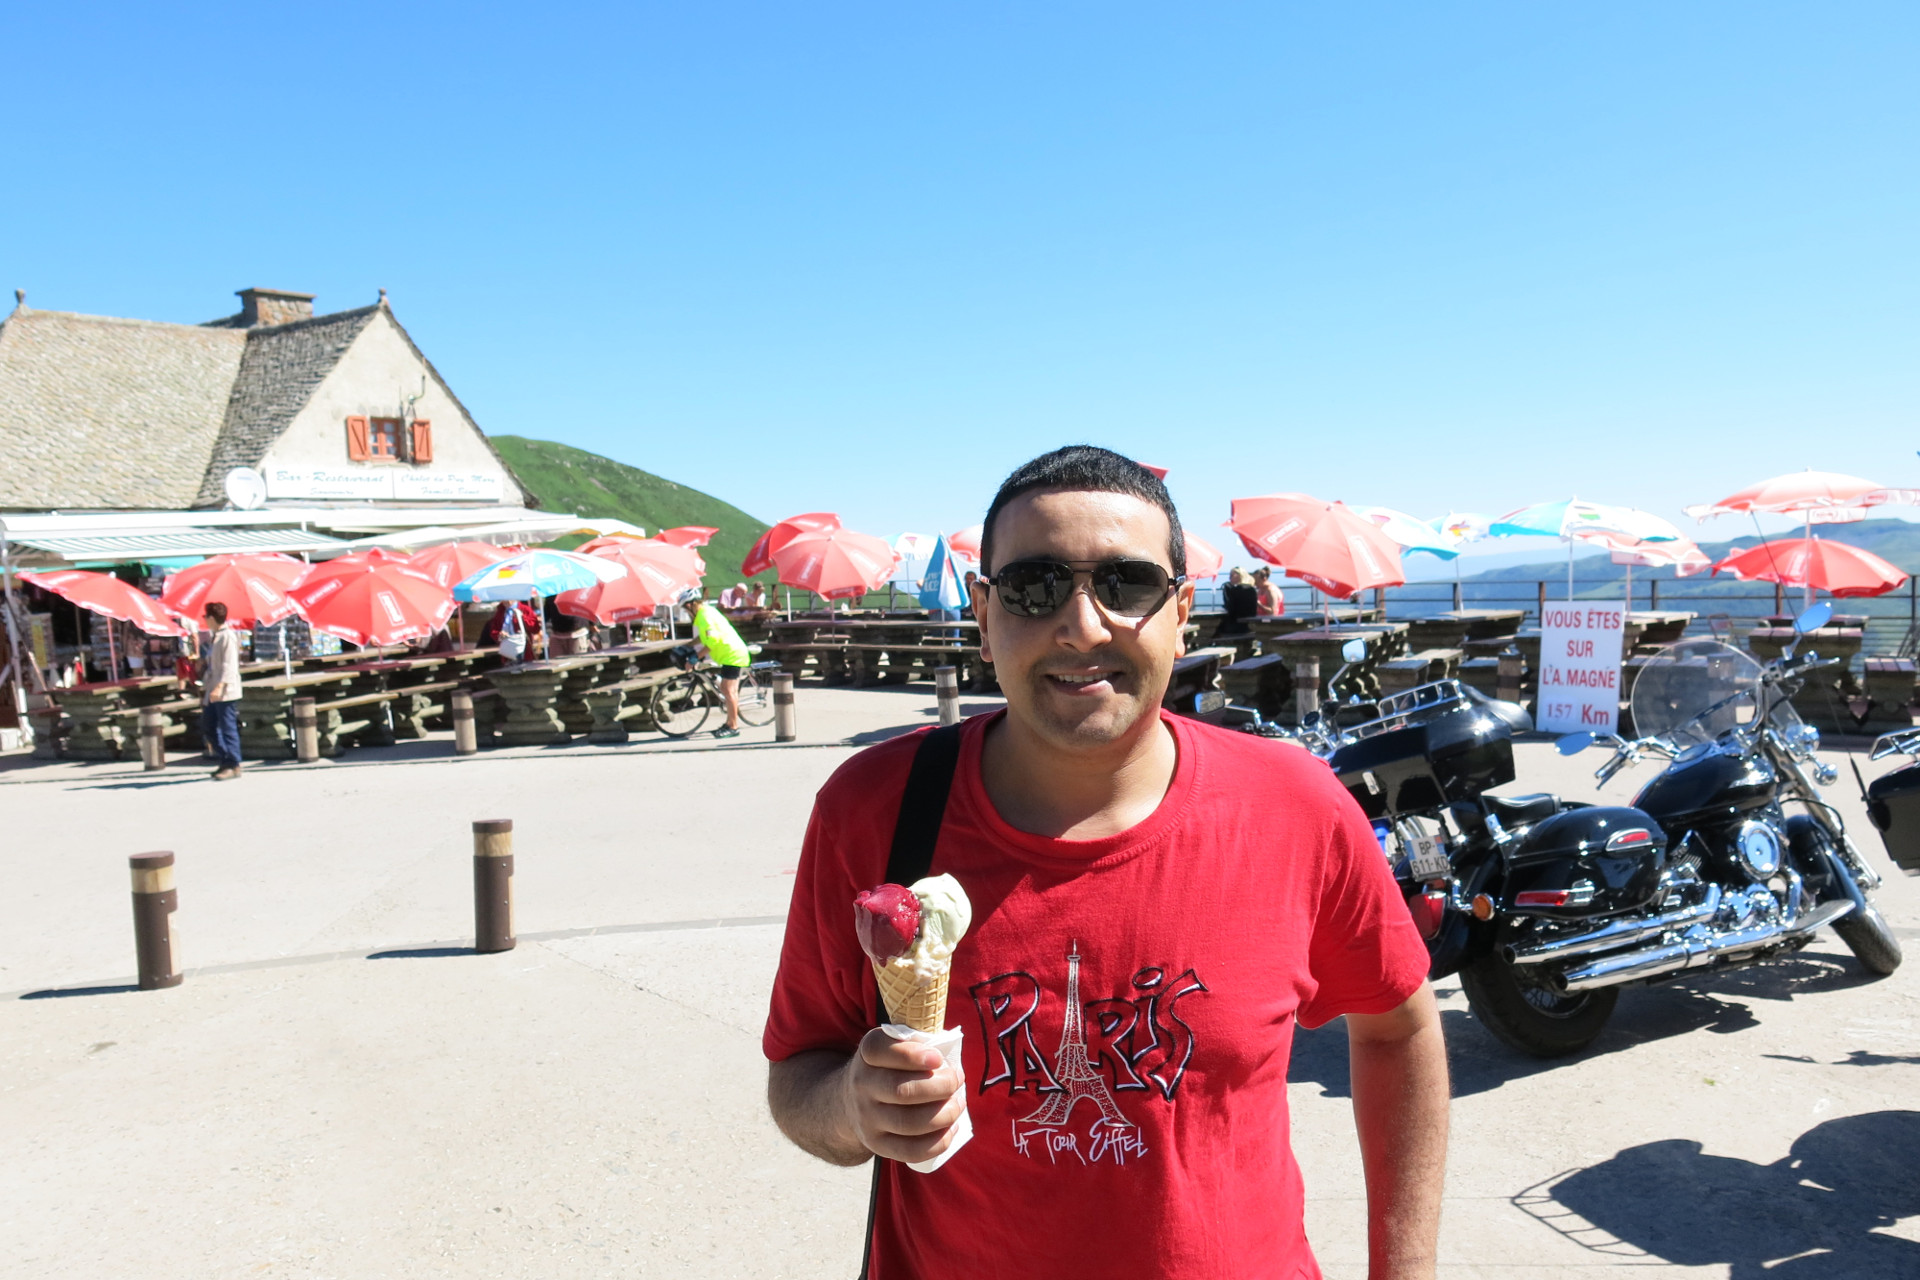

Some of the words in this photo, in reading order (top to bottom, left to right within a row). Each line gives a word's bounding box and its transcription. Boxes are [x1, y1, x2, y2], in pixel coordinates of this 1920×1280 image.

[1545, 610, 1582, 628] VOUS
[1587, 608, 1621, 629] ÊTES
[1566, 640, 1594, 657] SUR
[1547, 703, 1573, 718] 157
[1581, 703, 1609, 725] Km
